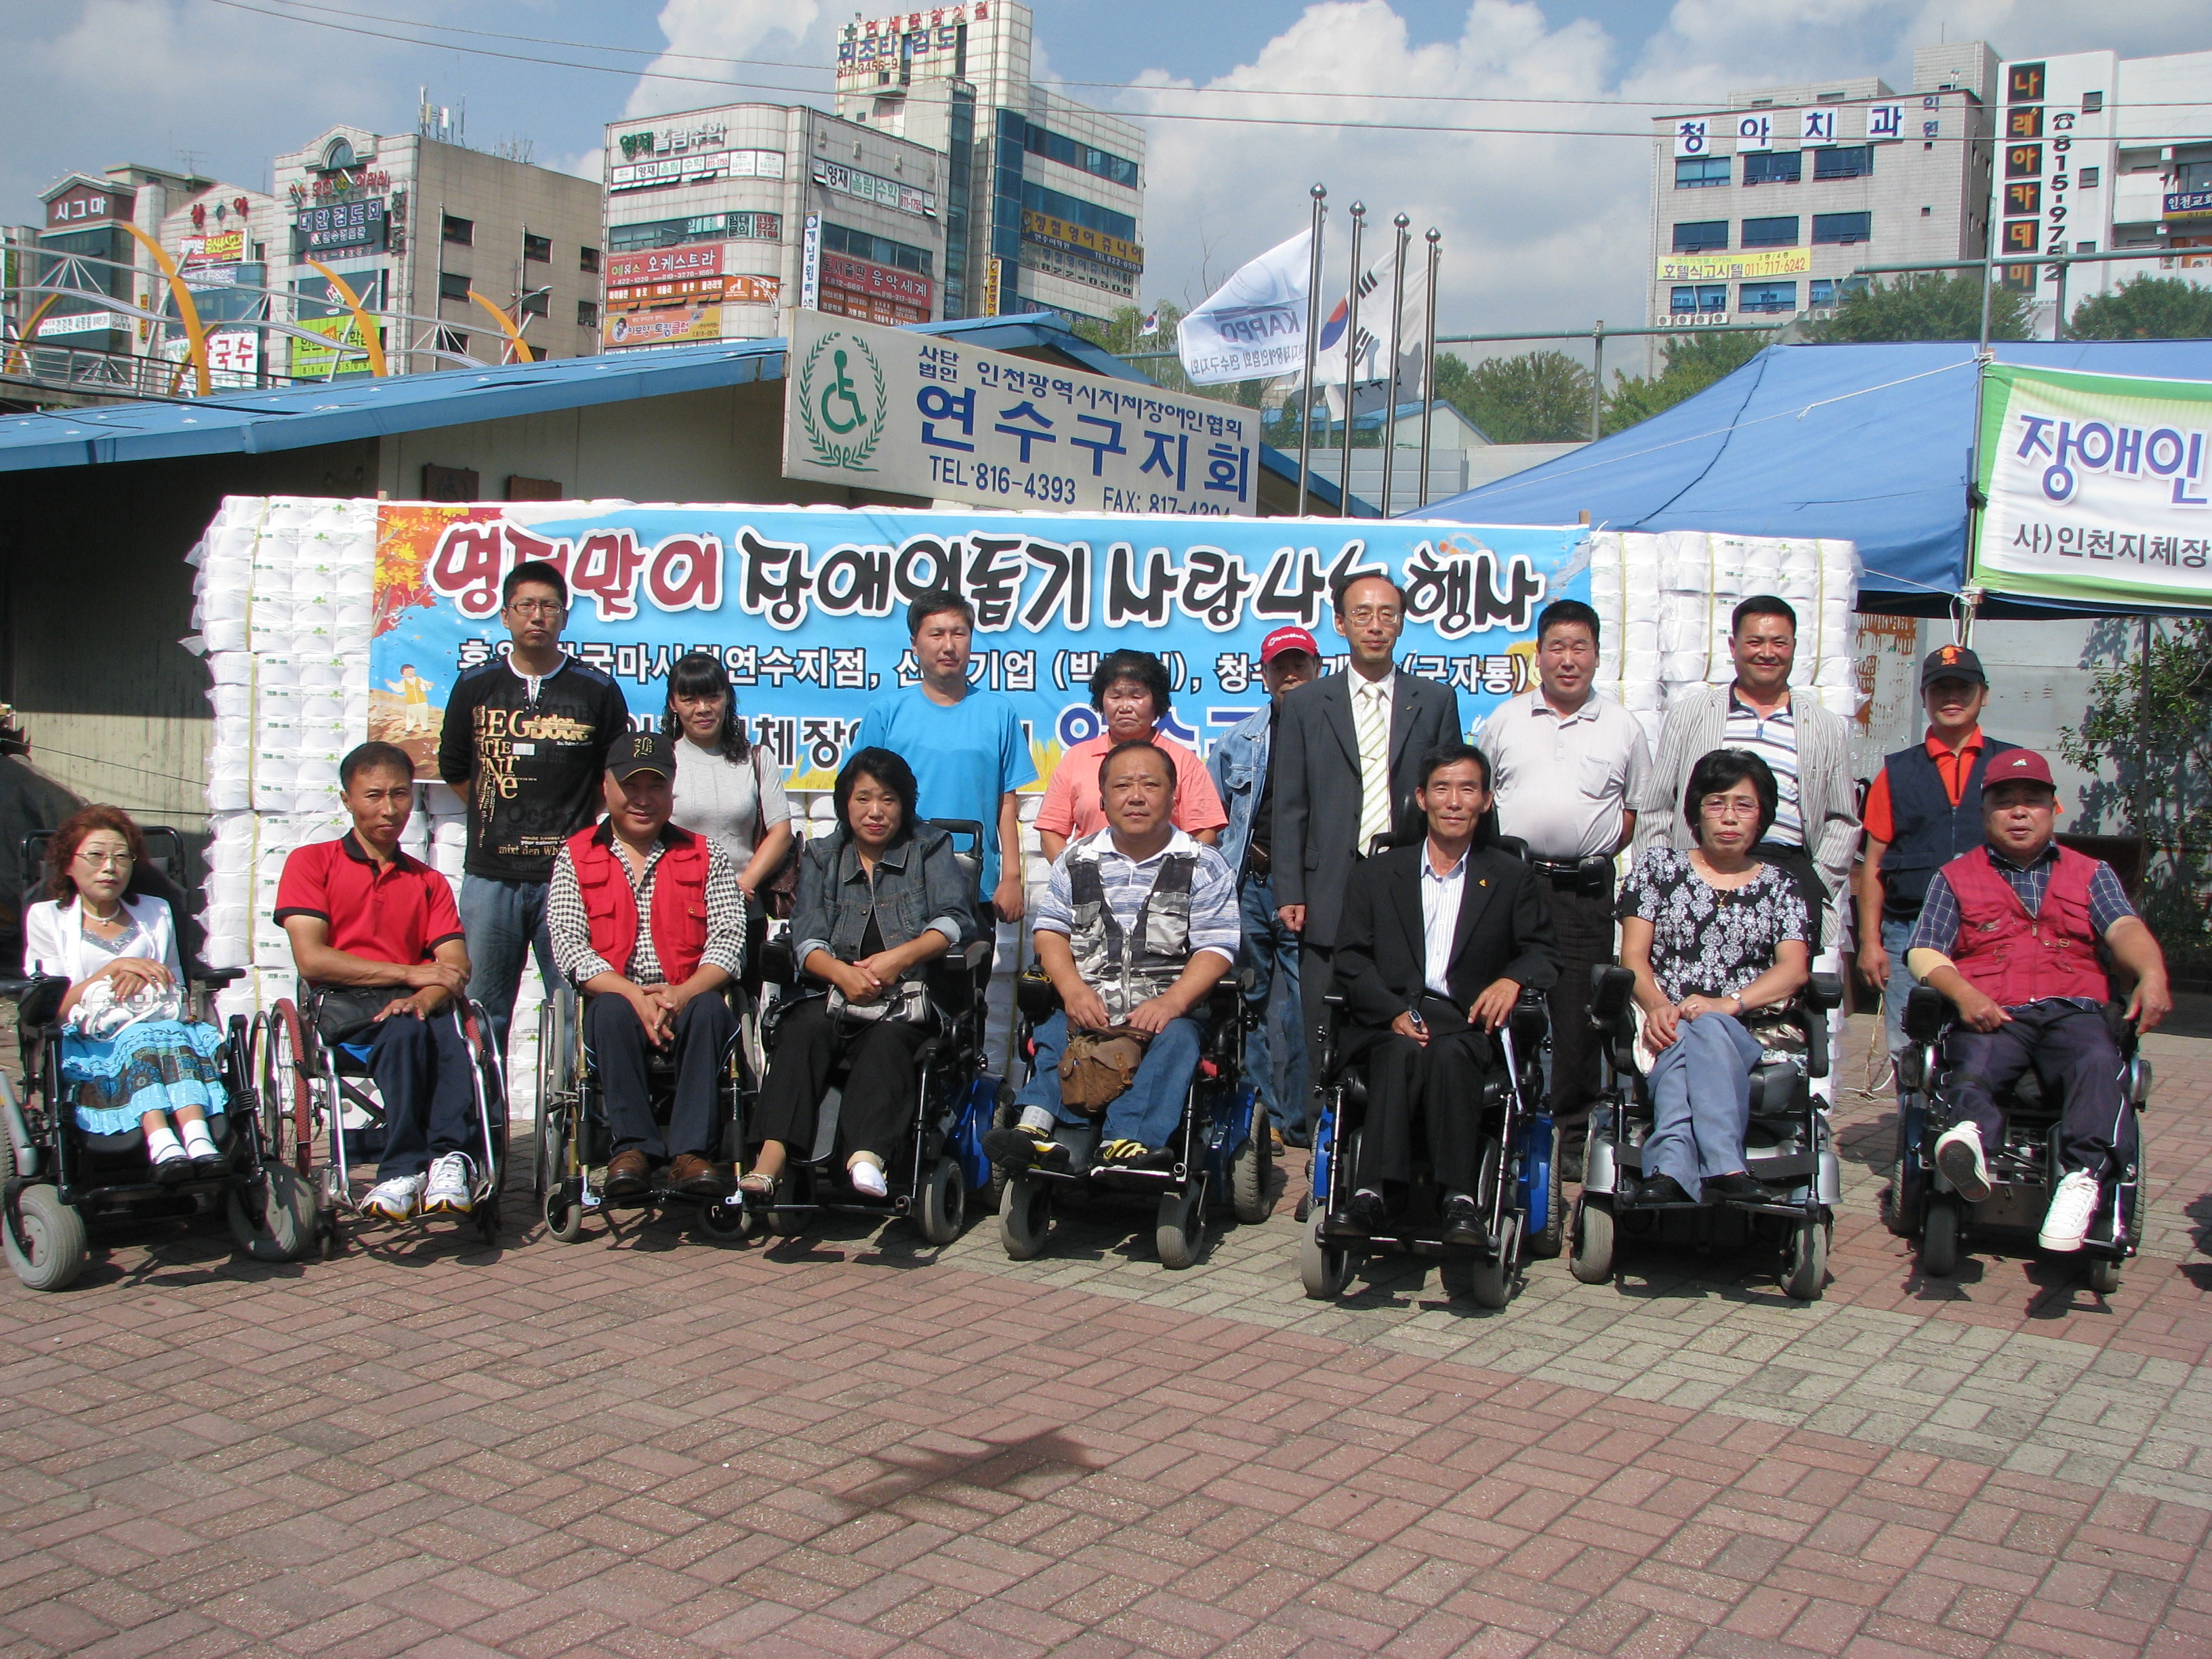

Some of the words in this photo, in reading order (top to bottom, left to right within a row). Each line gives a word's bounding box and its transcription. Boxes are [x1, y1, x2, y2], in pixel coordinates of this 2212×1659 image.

[827, 165, 848, 188] 영재
[55, 196, 106, 221] 시그마
[299, 200, 382, 232] 대한검도회
[647, 249, 716, 272] 오케스트라
[1094, 251, 1105, 262] TEL
[871, 269, 926, 298] 음악세계
[918, 345, 959, 367] 사단
[918, 362, 958, 384] 법인
[916, 385, 1251, 503] 연수구지회
[2015, 414, 2208, 505] 장애인
[1408, 546, 1540, 632] 행사
